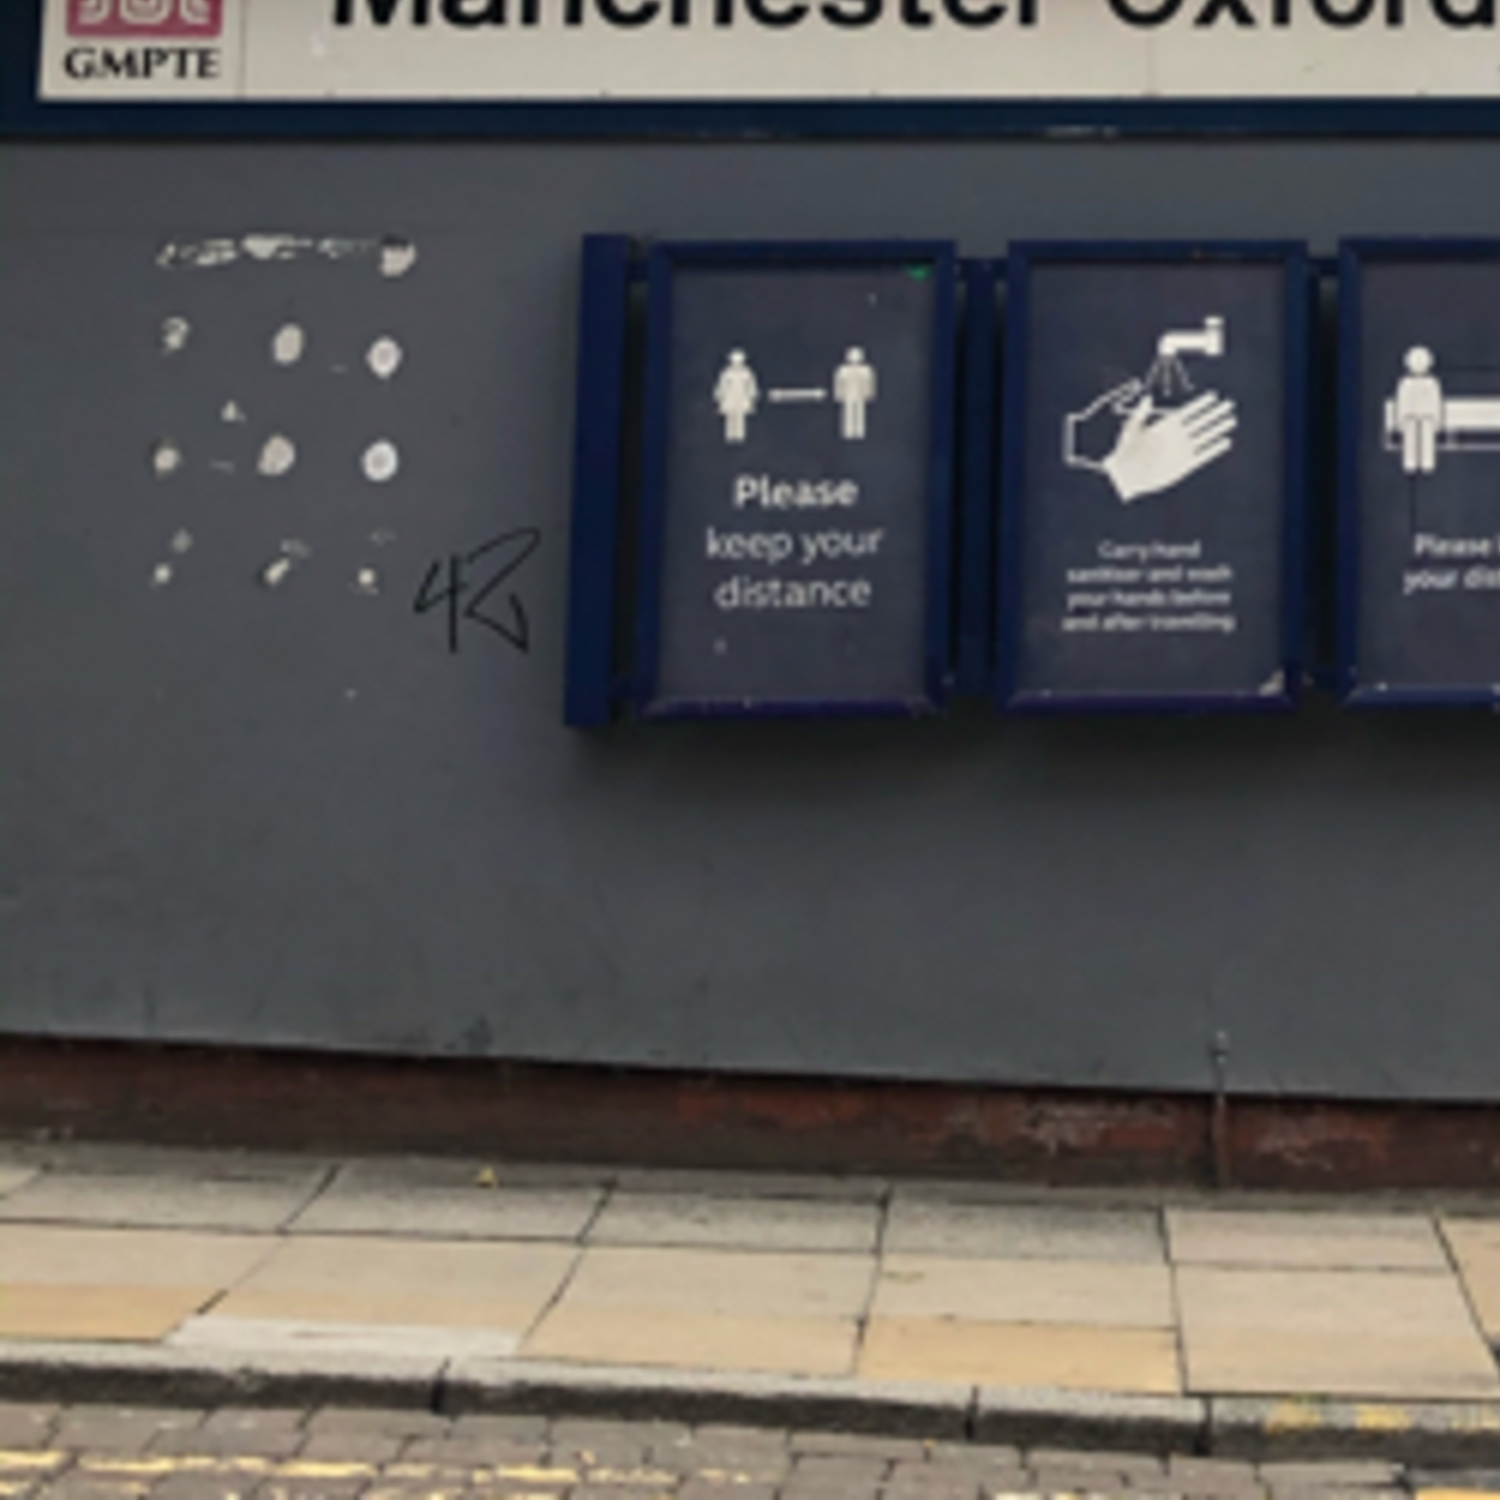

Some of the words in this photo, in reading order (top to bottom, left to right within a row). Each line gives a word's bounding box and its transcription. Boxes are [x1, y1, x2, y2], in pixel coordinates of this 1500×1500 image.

[64, 46, 222, 82] GMPTE
[734, 474, 859, 508] Please
[706, 526, 794, 563] keep
[801, 528, 884, 565] your
[1415, 533, 1491, 558] Please
[714, 576, 873, 609] distance
[1402, 570, 1458, 596] your
